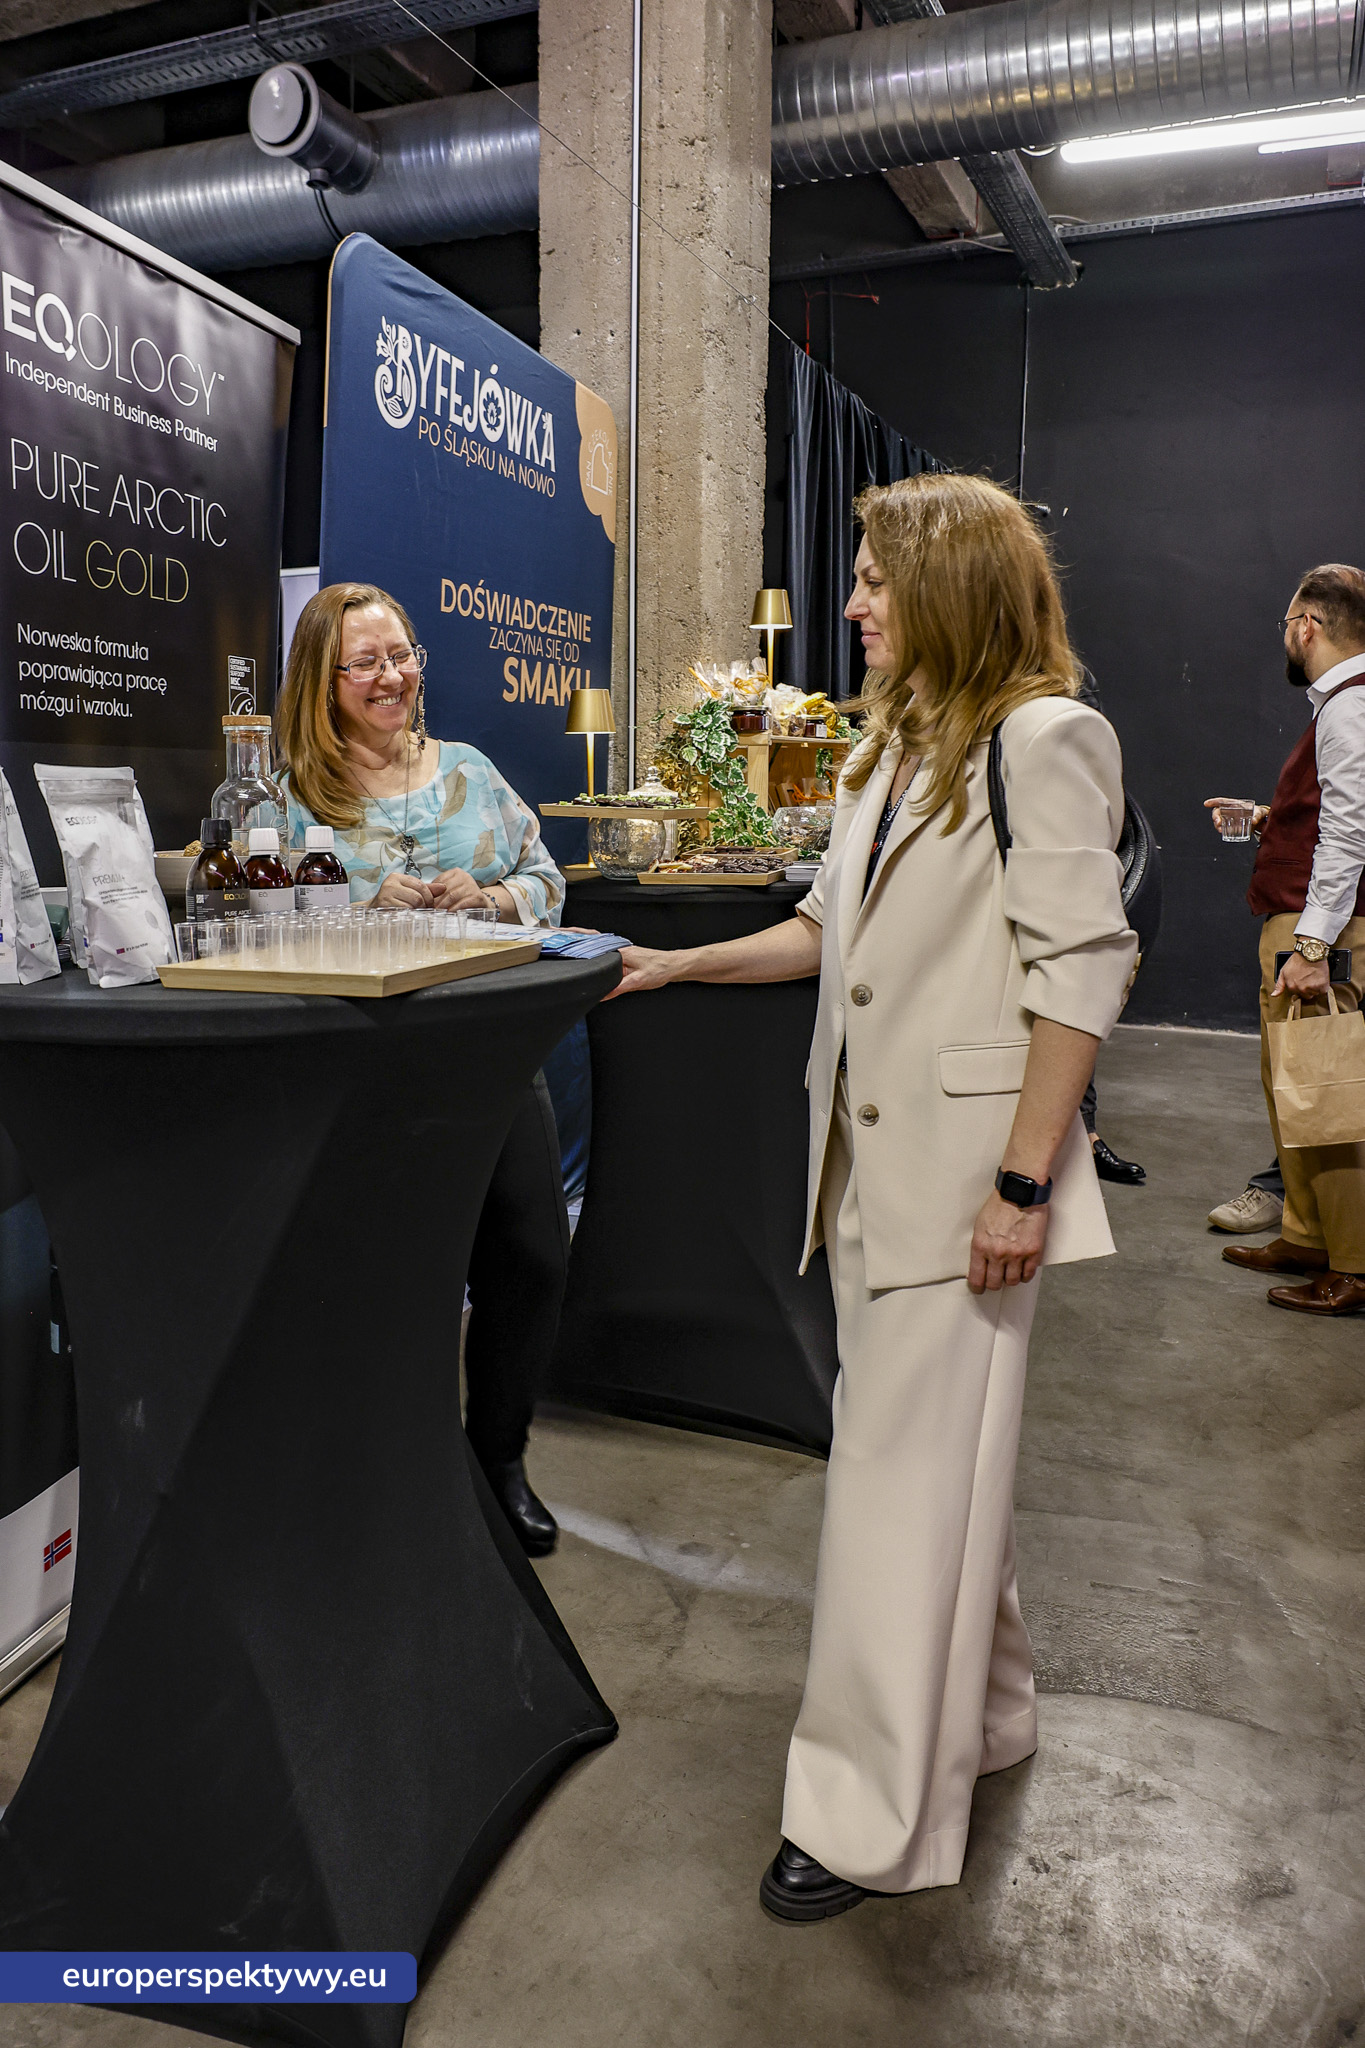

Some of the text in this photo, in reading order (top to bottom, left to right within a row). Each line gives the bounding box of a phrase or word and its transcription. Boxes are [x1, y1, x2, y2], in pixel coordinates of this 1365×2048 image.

[5, 351, 218, 452] Independent Business Partner
[374, 315, 557, 473] BYFEJÓWKA
[10, 438, 227, 547] PURE ARCTIC
[418, 415, 556, 499] PO ŚLĄSKU NA NOWO
[13, 521, 190, 603] OIL GOLD
[17, 623, 149, 661] Norweska formuła
[440, 577, 592, 644] DOŚWIADCZENIE
[489, 627, 580, 666] ZACZYNA SIĘ OD
[18, 659, 168, 695] poprawiająca pracę
[20, 691, 133, 718] mózgu i wzroku.
